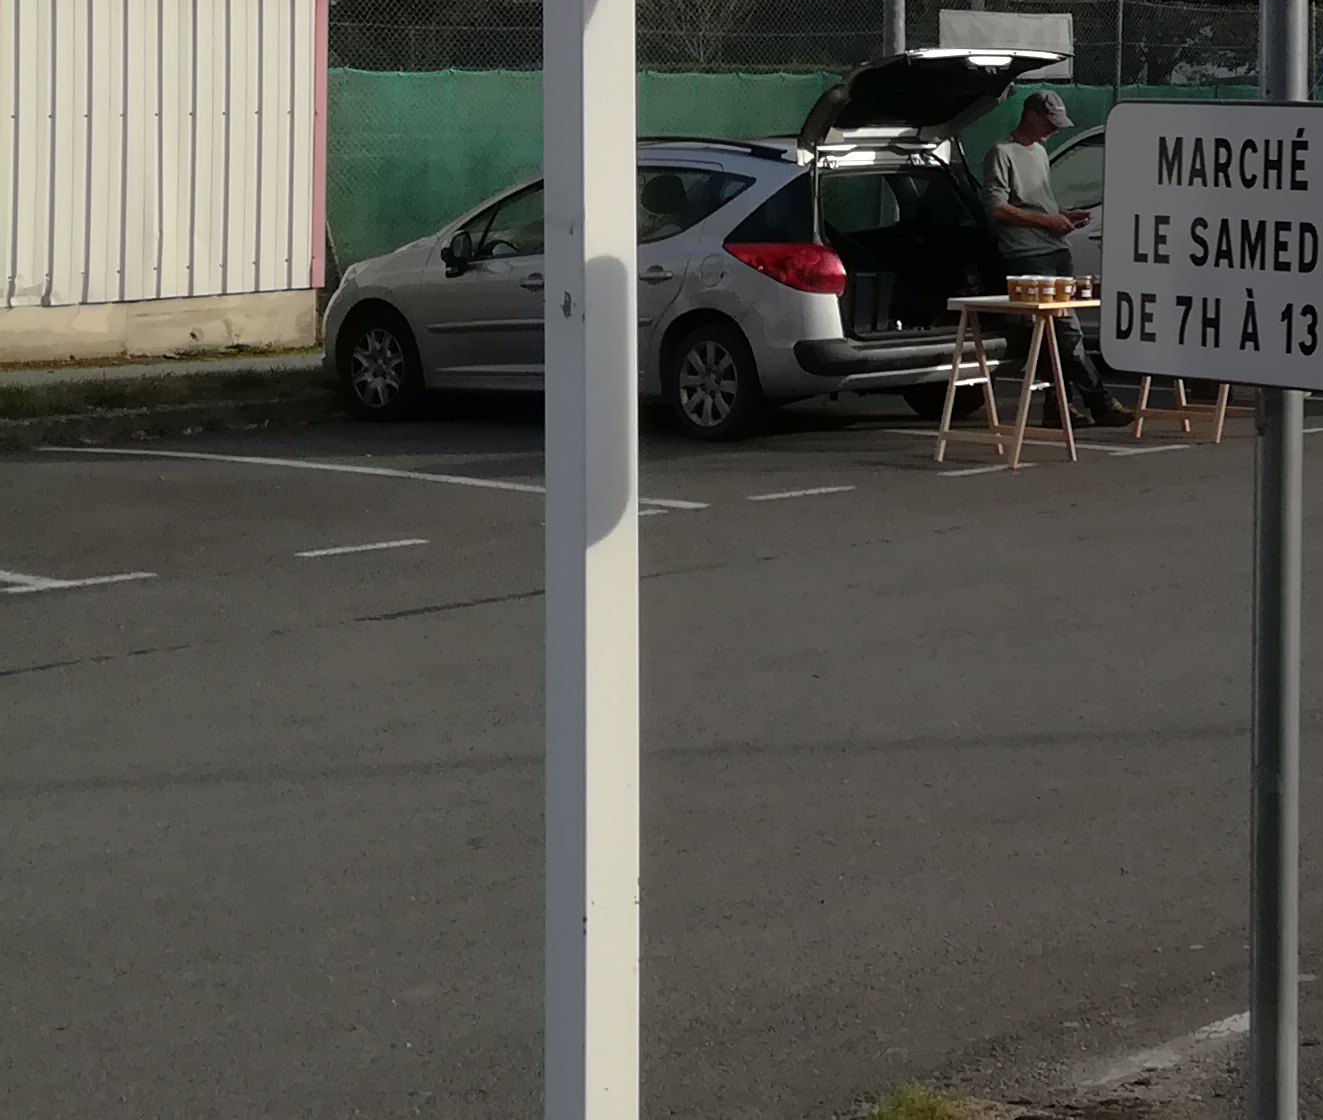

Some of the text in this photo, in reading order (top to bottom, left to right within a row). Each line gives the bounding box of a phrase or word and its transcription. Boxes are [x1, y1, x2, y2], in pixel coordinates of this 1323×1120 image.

[1157, 128, 1309, 191] MARCHÉ
[1133, 214, 1171, 265] LE
[1116, 291, 1157, 343] DE
[1175, 296, 1221, 349] 7H
[1239, 288, 1261, 352] À
